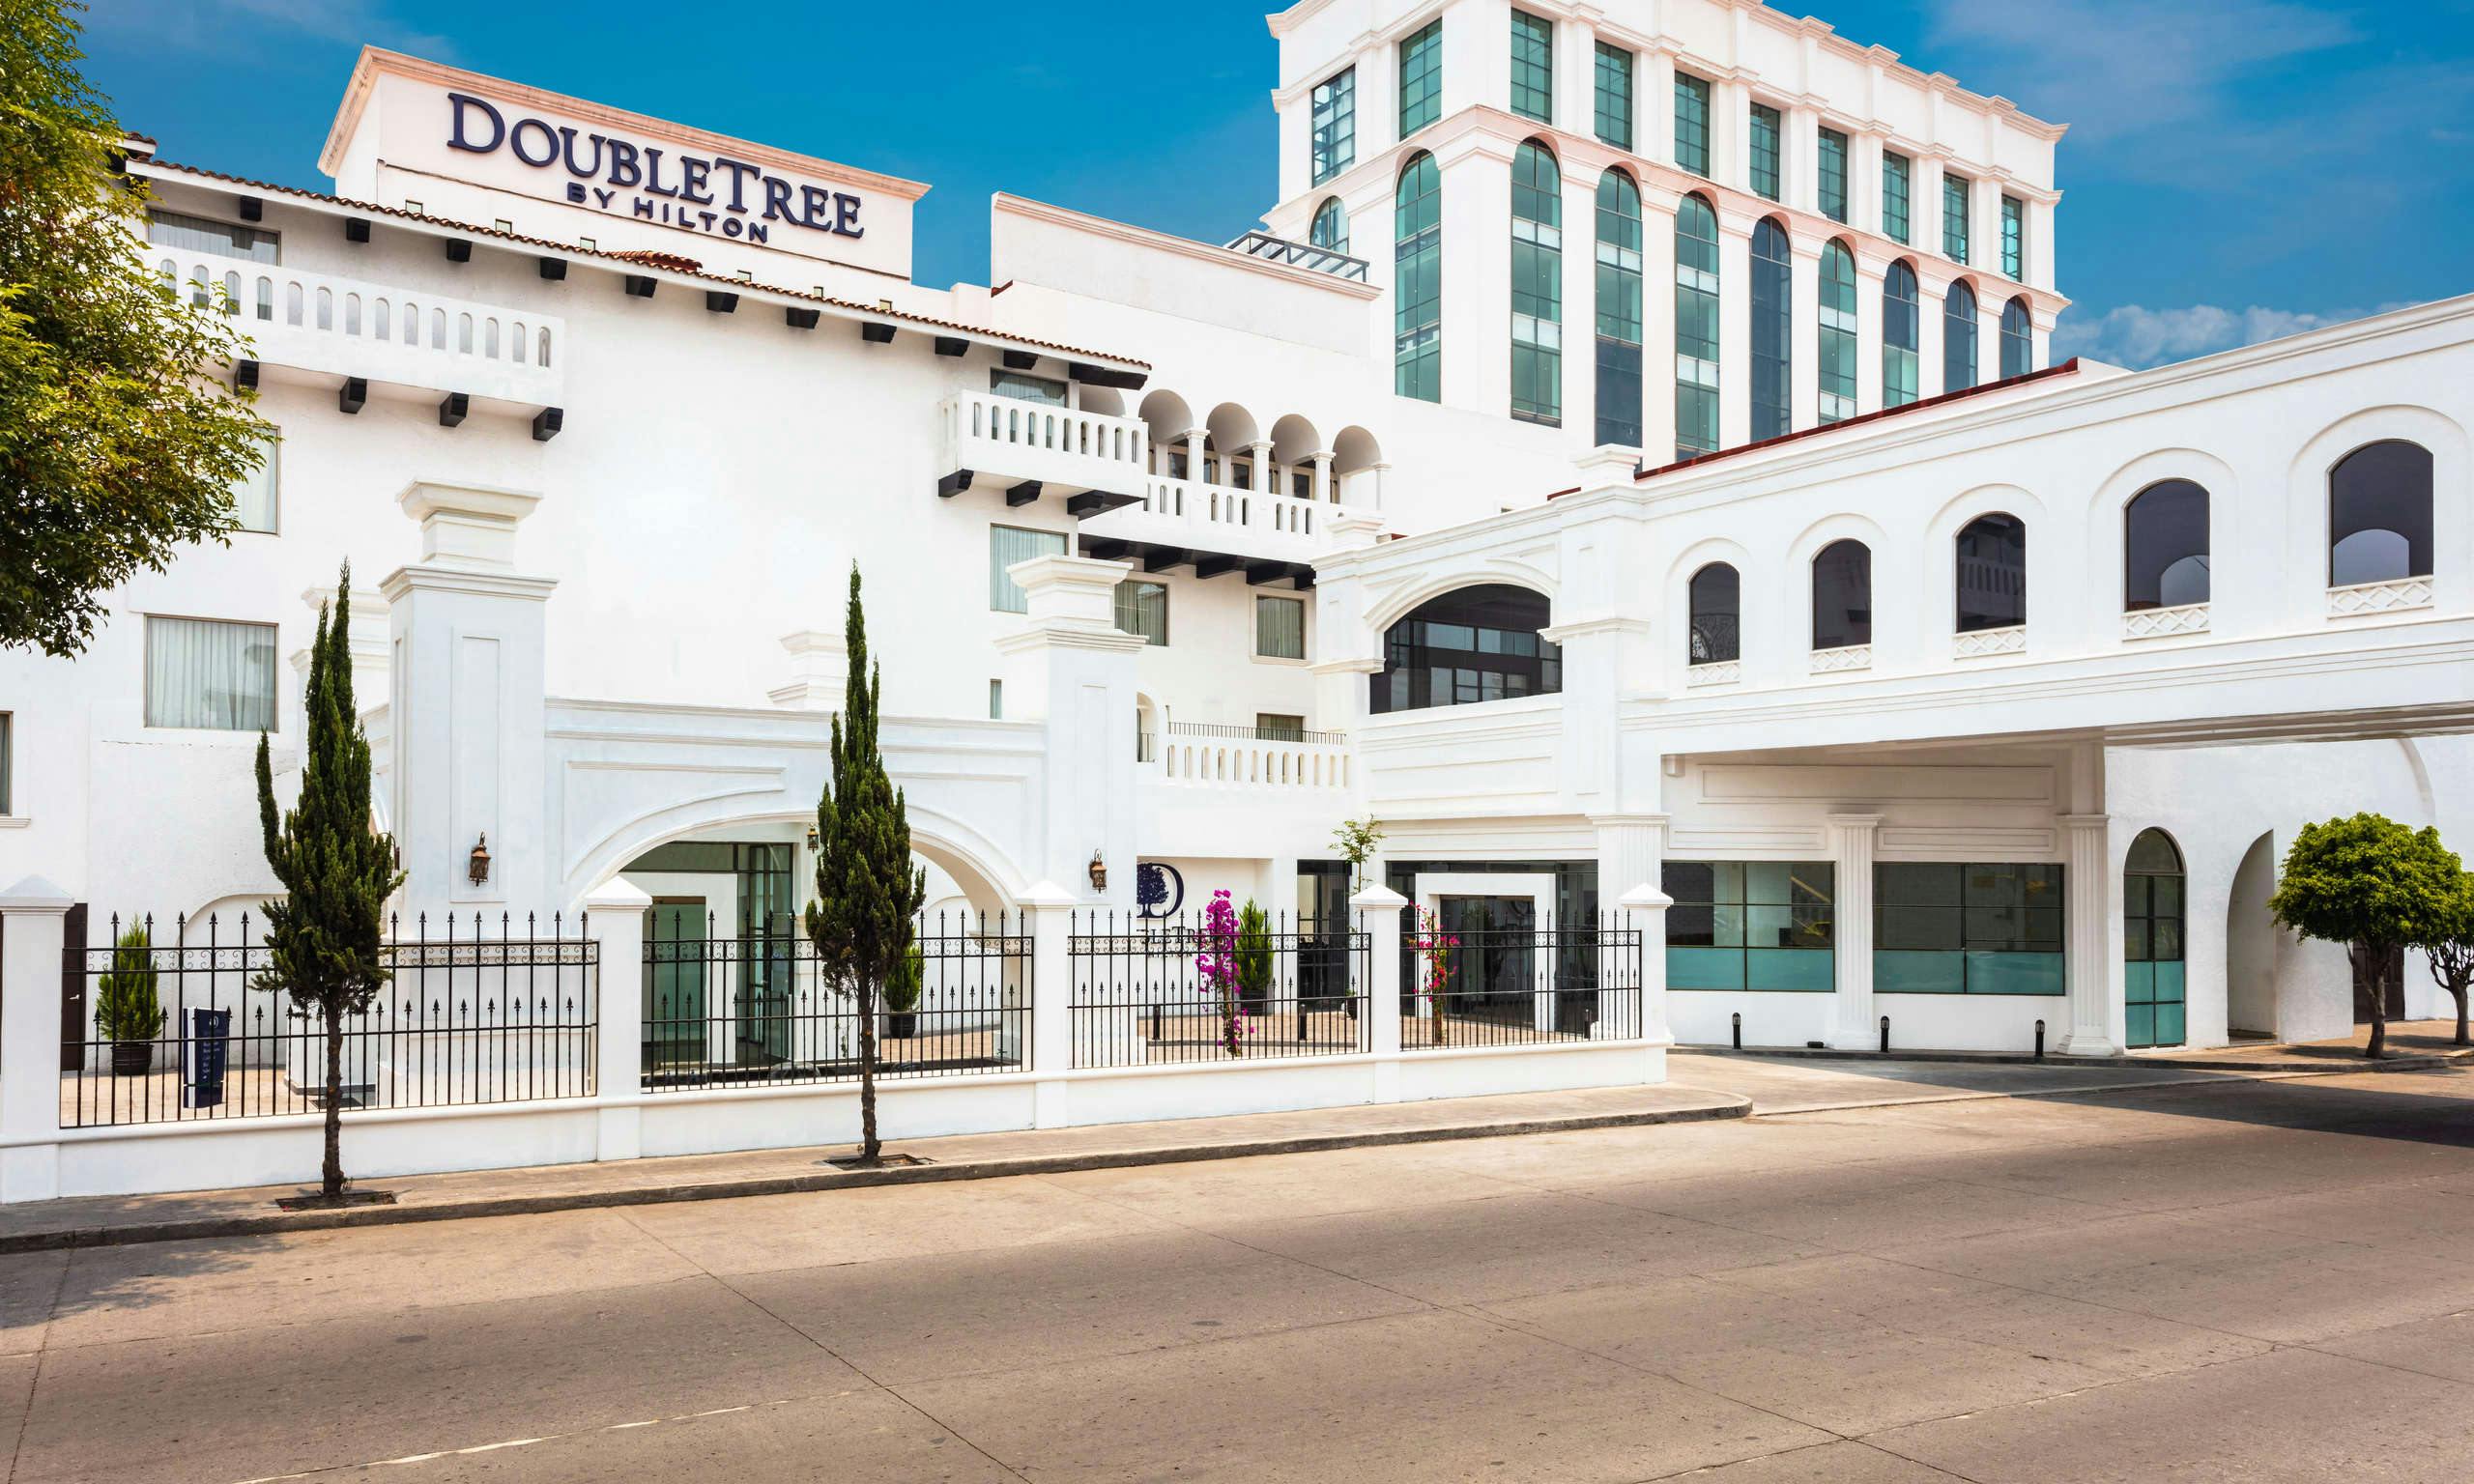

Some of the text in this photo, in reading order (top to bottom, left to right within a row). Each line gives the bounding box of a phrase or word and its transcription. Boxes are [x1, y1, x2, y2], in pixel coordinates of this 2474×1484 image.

[448, 93, 864, 238] DOUBLETREE
[567, 182, 768, 243] BY HILTON
